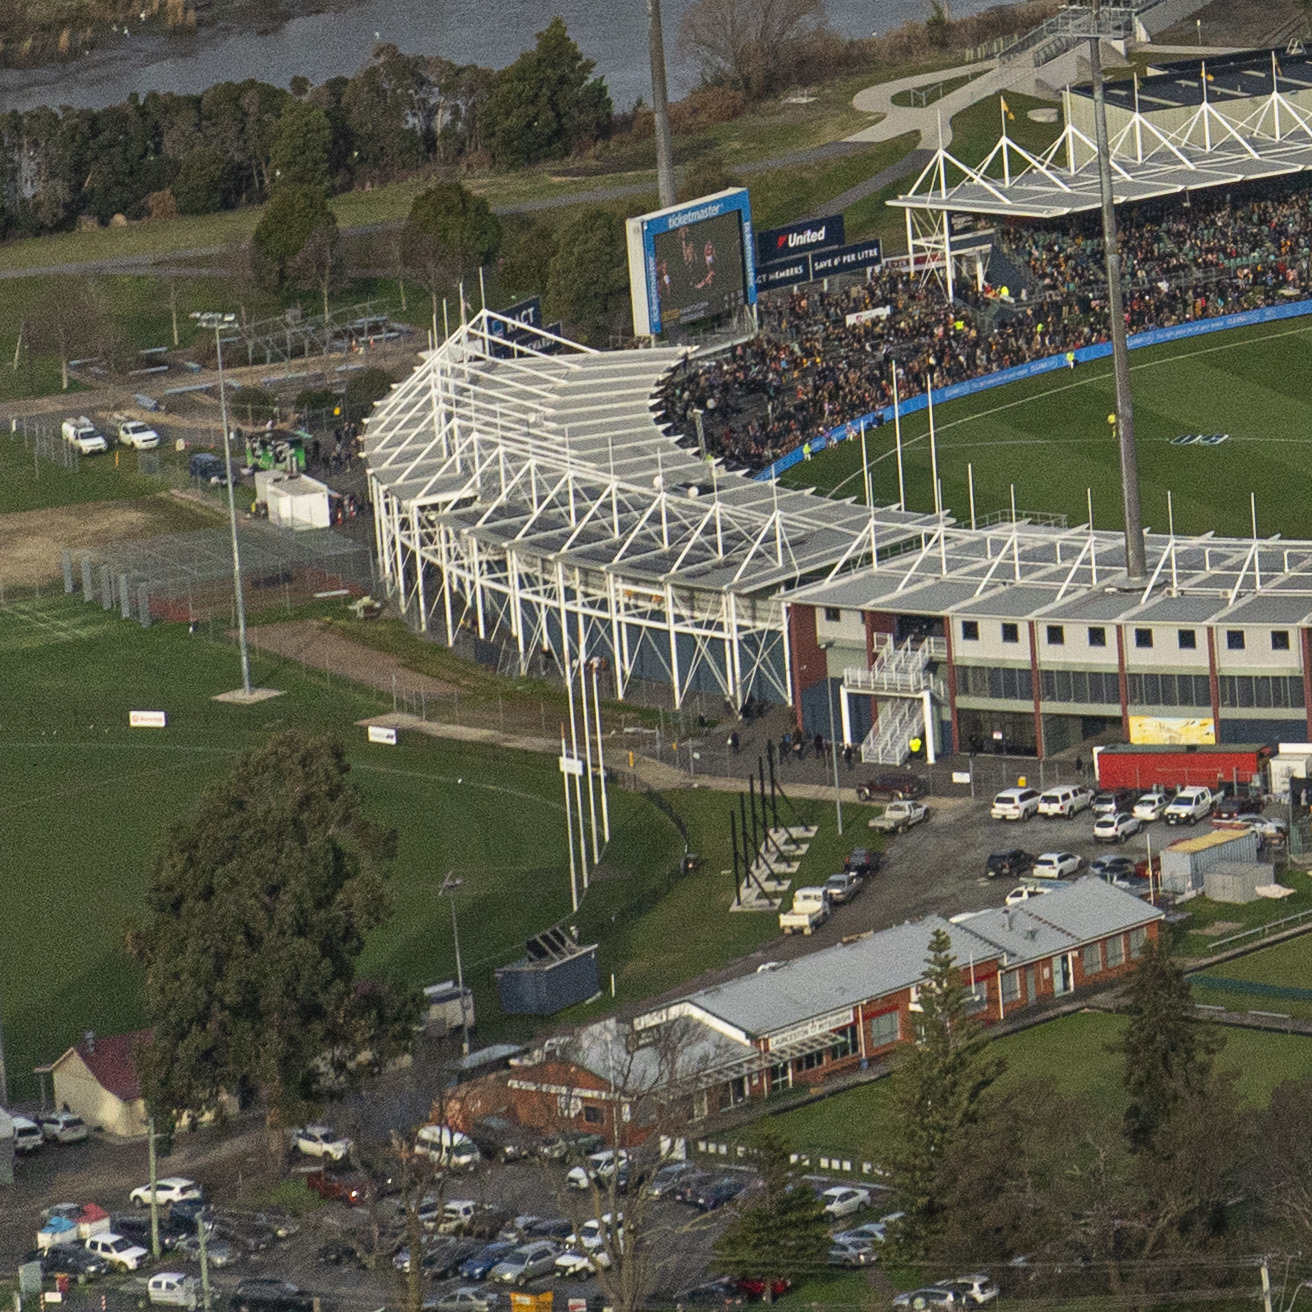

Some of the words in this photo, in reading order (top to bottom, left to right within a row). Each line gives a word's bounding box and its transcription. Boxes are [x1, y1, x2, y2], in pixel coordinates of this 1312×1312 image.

[668, 203, 720, 230] ticketmaster
[788, 226, 826, 248] United
[814, 259, 832, 272] SAVE
[842, 252, 856, 265] PER
[857, 248, 878, 261] LITRE
[768, 265, 804, 282] MEMBERS
